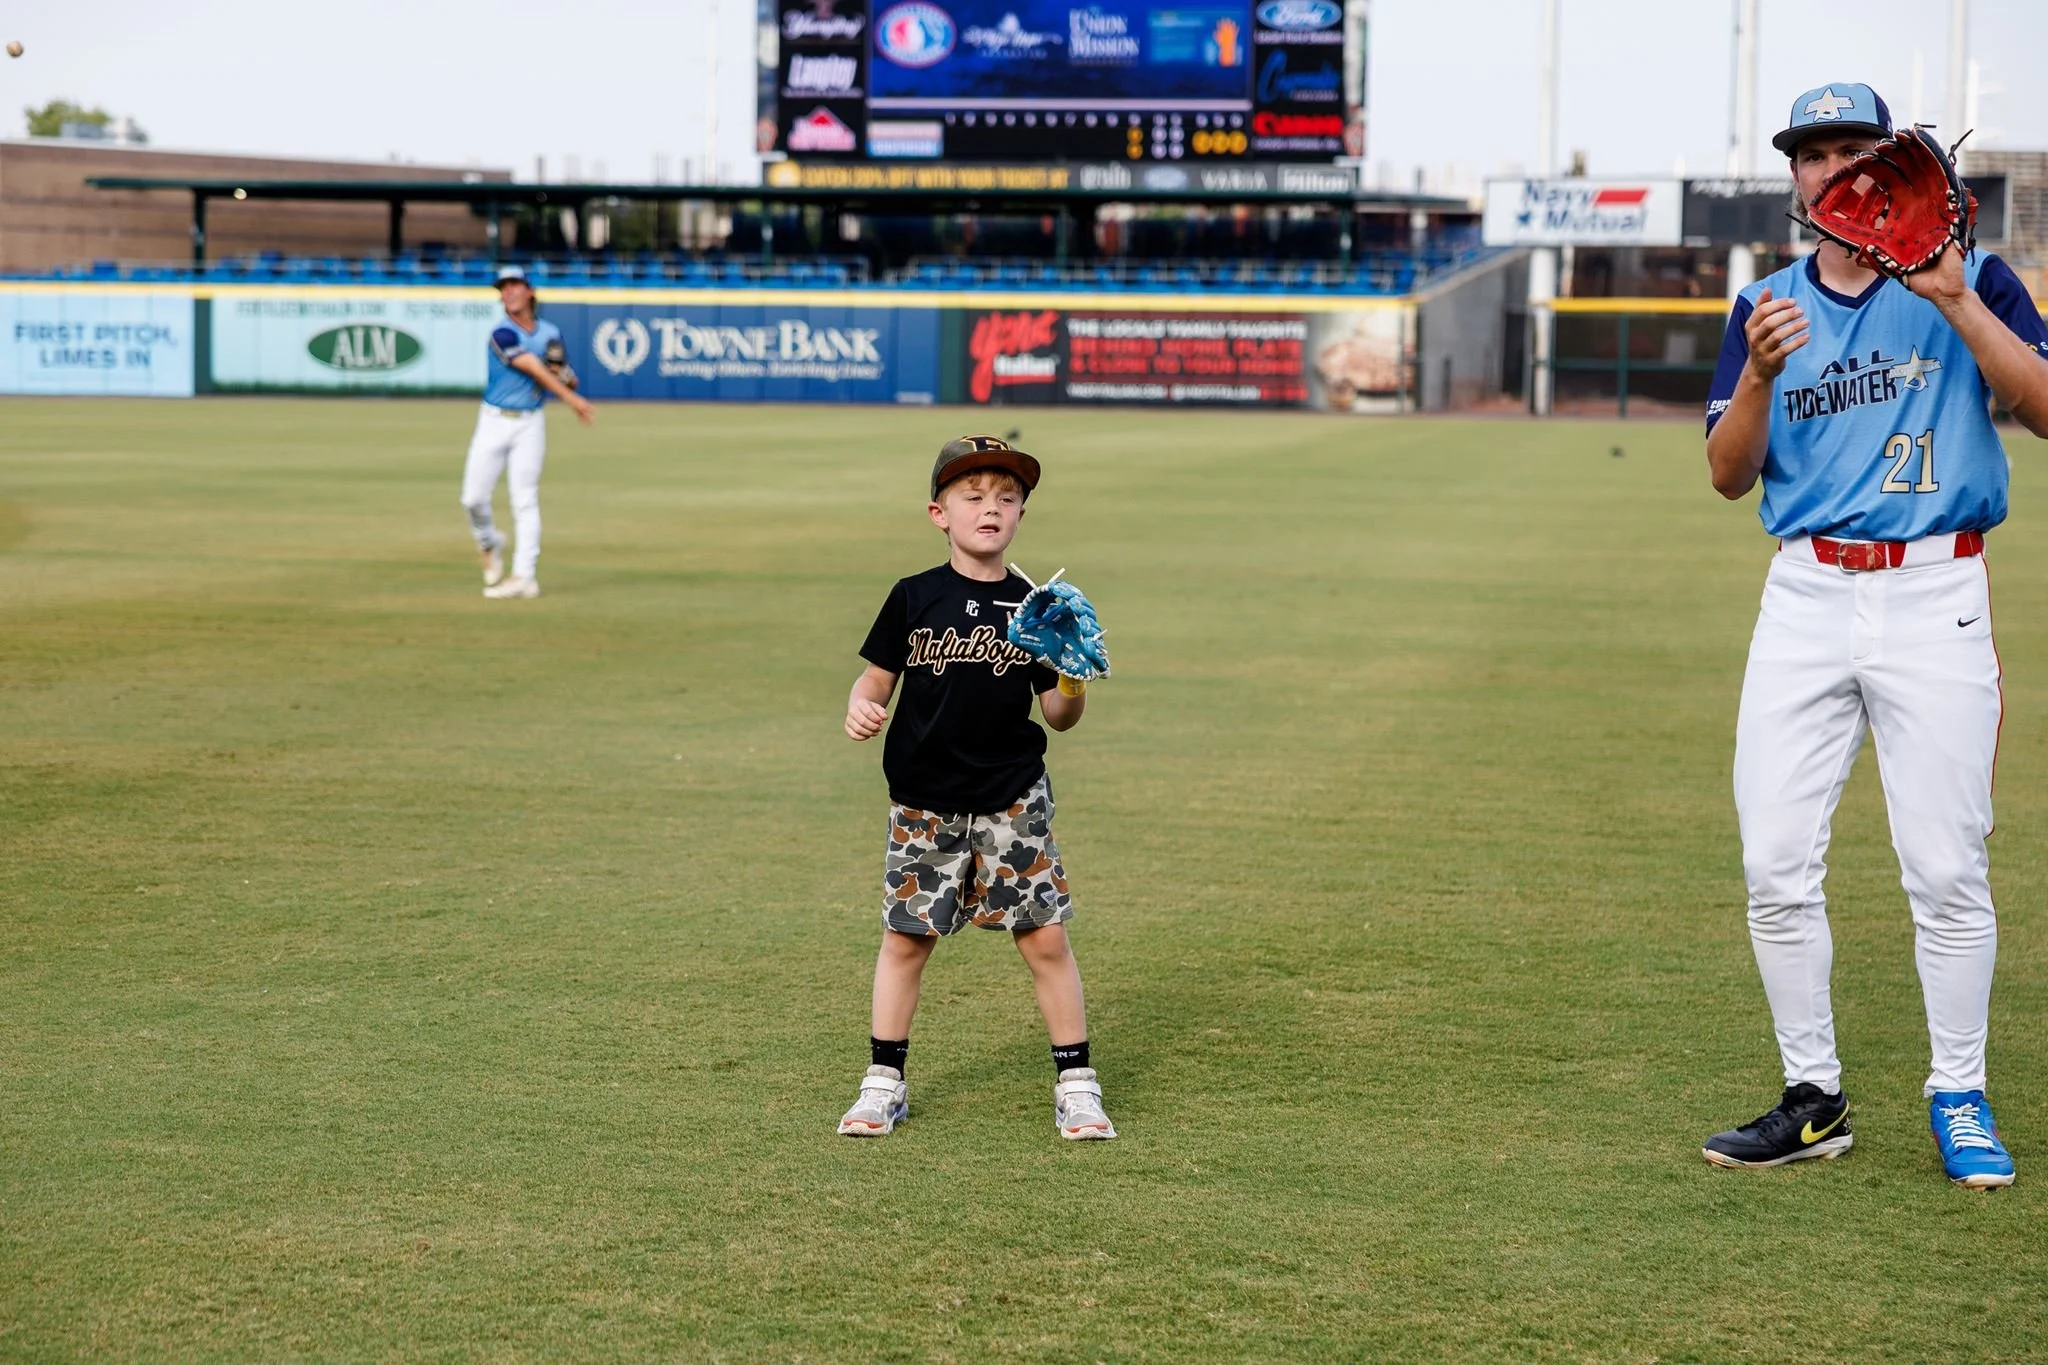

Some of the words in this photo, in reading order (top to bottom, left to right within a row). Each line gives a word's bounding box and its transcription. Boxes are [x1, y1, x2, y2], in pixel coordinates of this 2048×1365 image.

[15, 323, 84, 343] FIRST
[331, 327, 397, 368] ALM
[40, 350, 117, 368] LIMES
[126, 350, 152, 368] IN
[1819, 350, 1895, 380] ALL
[1783, 368, 1898, 423] TIDEWATER
[1880, 429, 1940, 494] 21
